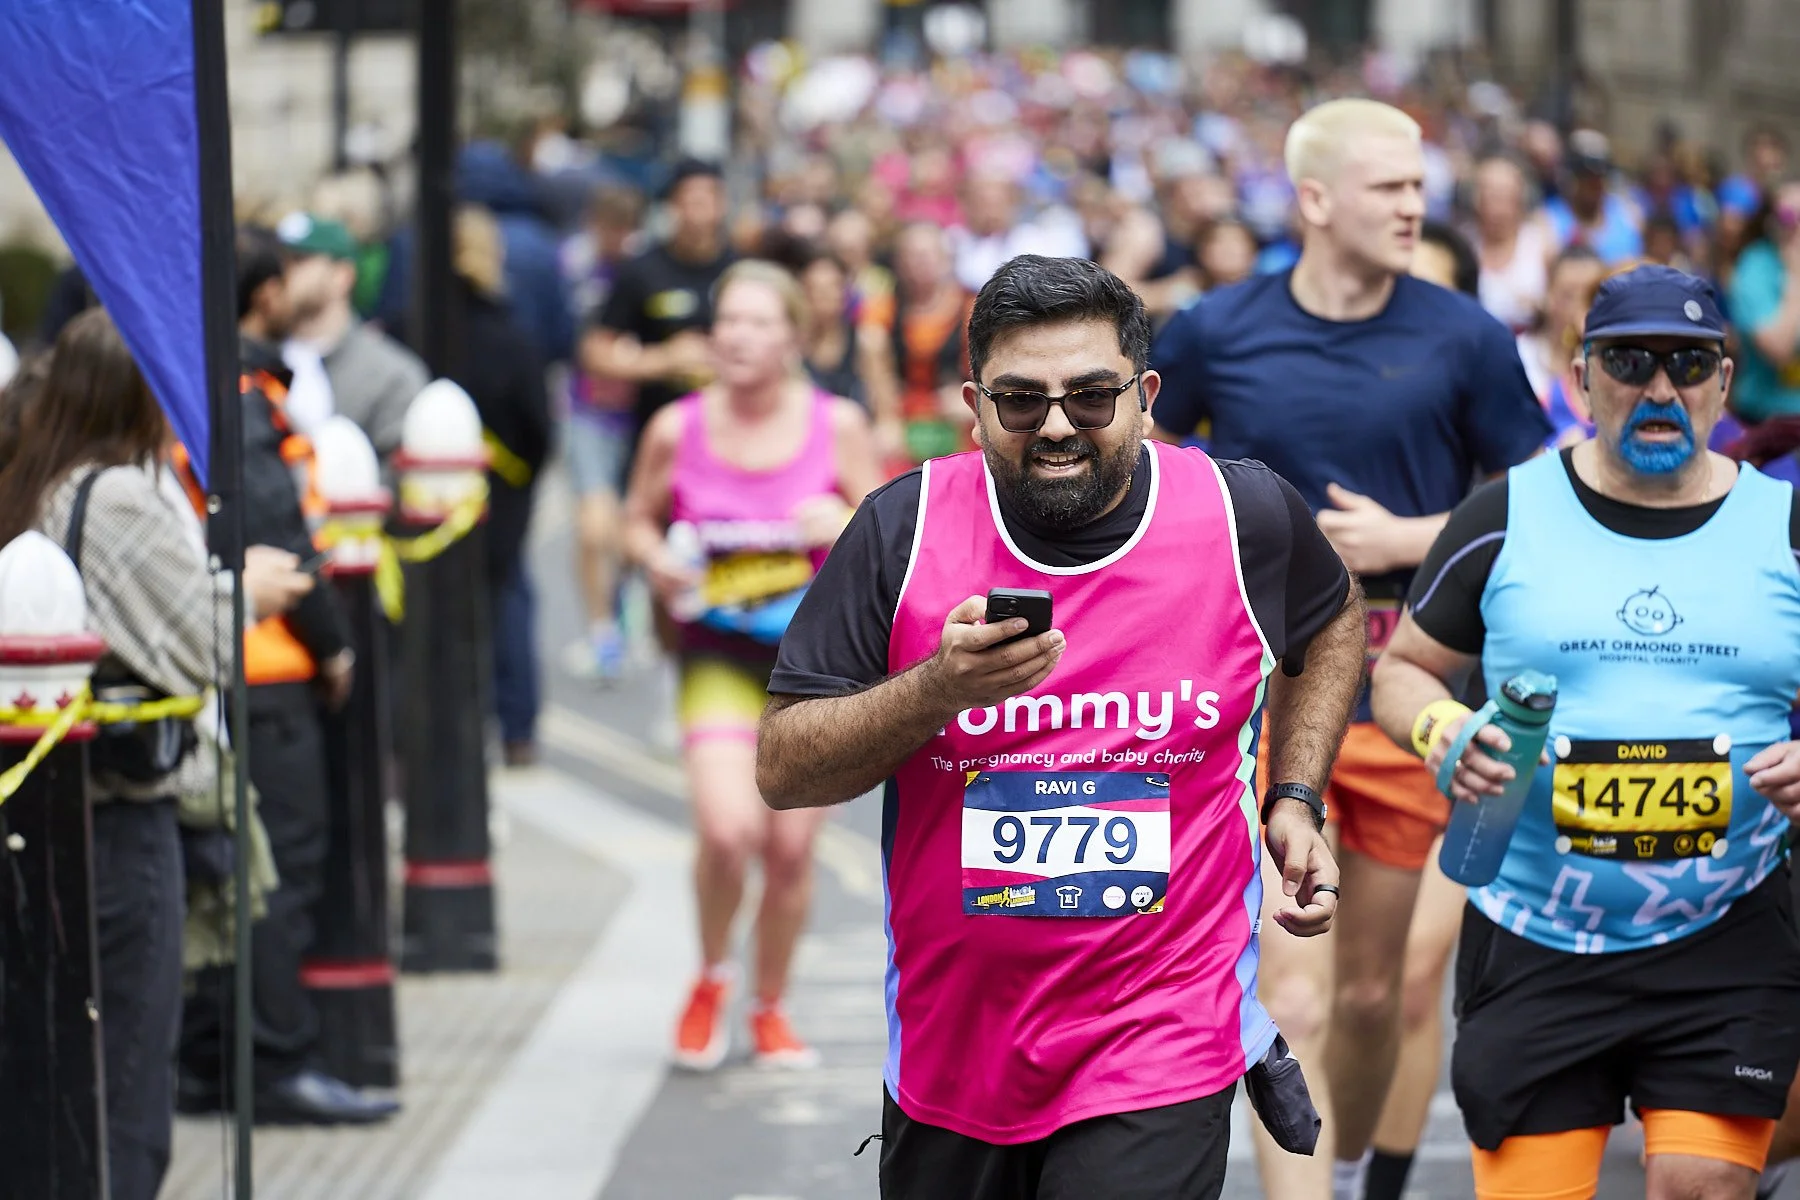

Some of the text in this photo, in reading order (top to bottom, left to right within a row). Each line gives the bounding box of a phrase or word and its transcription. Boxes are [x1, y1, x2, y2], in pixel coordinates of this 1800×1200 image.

[1559, 640, 1740, 657] GREAT ORMOND STREET
[1599, 654, 1699, 665] HOSPITAL CHARITY
[936, 680, 1221, 740] ommy's
[930, 748, 1206, 773] The pregnancy and baby charity
[1617, 745, 1667, 759] DAVID
[1035, 781, 1096, 795] RAVI G
[1567, 776, 1721, 817] 14743
[992, 815, 1138, 865] 9779
[1138, 896, 1145, 904] 4
